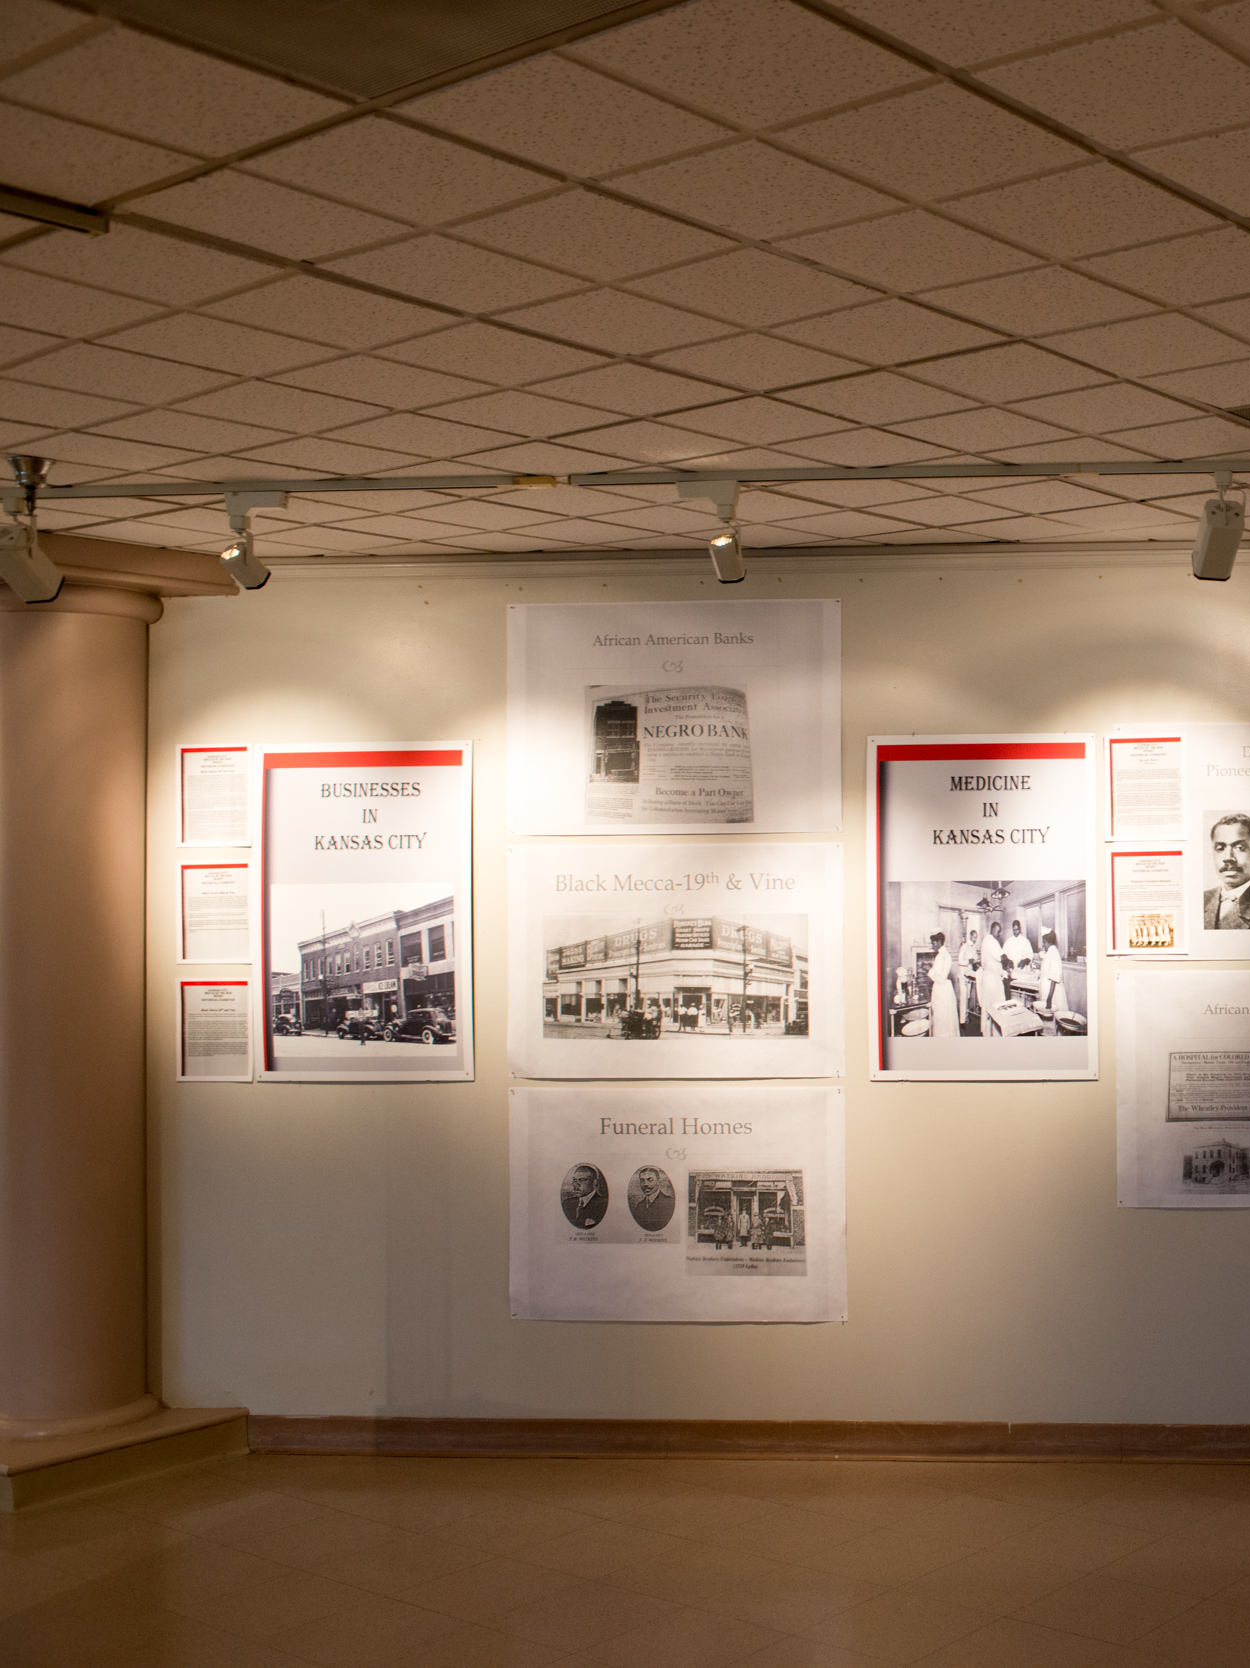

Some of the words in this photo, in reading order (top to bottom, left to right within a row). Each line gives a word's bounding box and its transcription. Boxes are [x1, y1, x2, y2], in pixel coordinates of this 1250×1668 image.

[592, 634, 641, 647] African
[645, 633, 710, 646] American
[713, 632, 755, 645] Banks
[644, 703, 697, 715] Investment
[643, 723, 705, 739] NEGRO
[708, 723, 749, 741] BANK
[320, 781, 422, 798] BUSINESSES
[949, 775, 1031, 791] MEDICINE
[656, 786, 689, 796] Become
[699, 788, 716, 797] Part
[717, 788, 744, 797] Owner
[362, 808, 379, 824] IN
[982, 802, 999, 818] IN
[314, 834, 384, 851] KANSAS
[388, 831, 428, 850] CITY
[932, 829, 1005, 845] KANSAS
[1010, 825, 1051, 844] CITY
[555, 873, 608, 891] Black
[613, 871, 720, 891] Mecca-19th
[726, 872, 743, 891] &
[750, 872, 796, 890] Vine
[614, 927, 658, 947] DRUGS
[1203, 1003, 1250, 1015] African
[600, 1117, 675, 1136] Funeral
[681, 1117, 753, 1136] Homes
